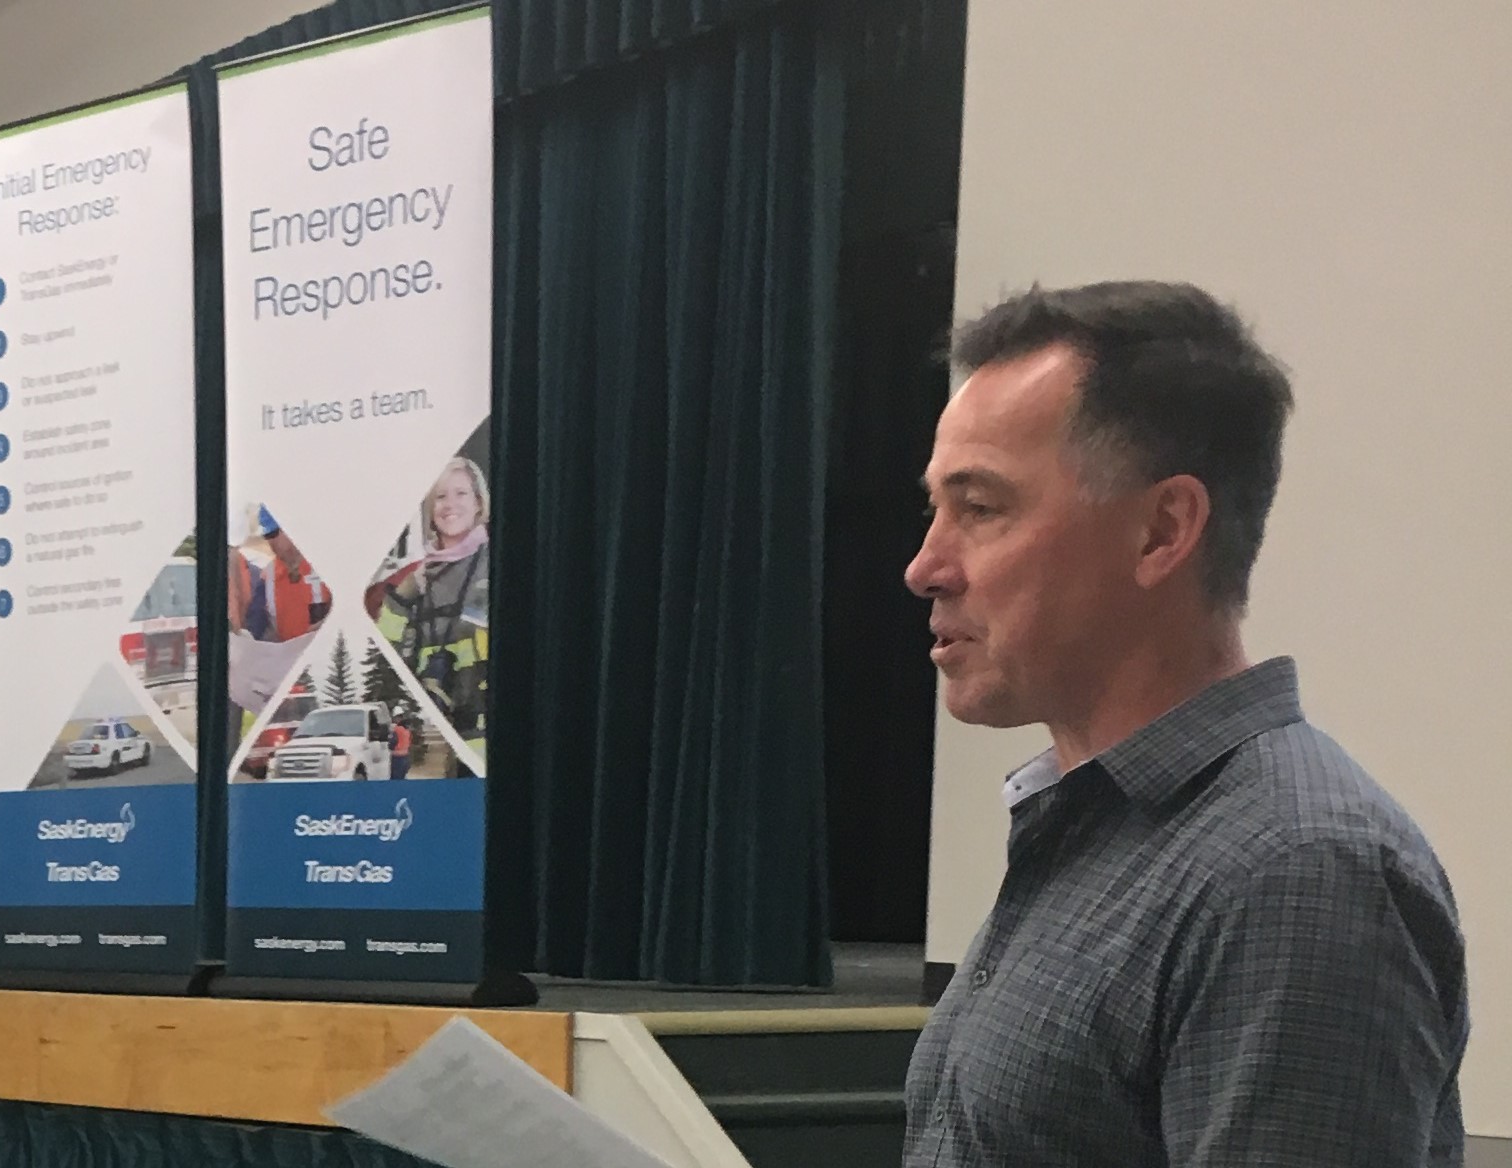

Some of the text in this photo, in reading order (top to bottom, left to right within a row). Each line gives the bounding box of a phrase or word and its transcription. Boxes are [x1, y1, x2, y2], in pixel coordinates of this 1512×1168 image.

[307, 117, 390, 172] Safe
[42, 146, 151, 191] Emergency
[19, 195, 119, 235] Response:
[249, 184, 454, 253] Emergency
[254, 259, 443, 321] Response.
[261, 388, 434, 431] It takes a team.
[37, 818, 128, 843] SaskEnergy
[294, 814, 405, 841] SaskEnergy
[45, 860, 120, 882] TransGas
[304, 859, 393, 883] TransGas
